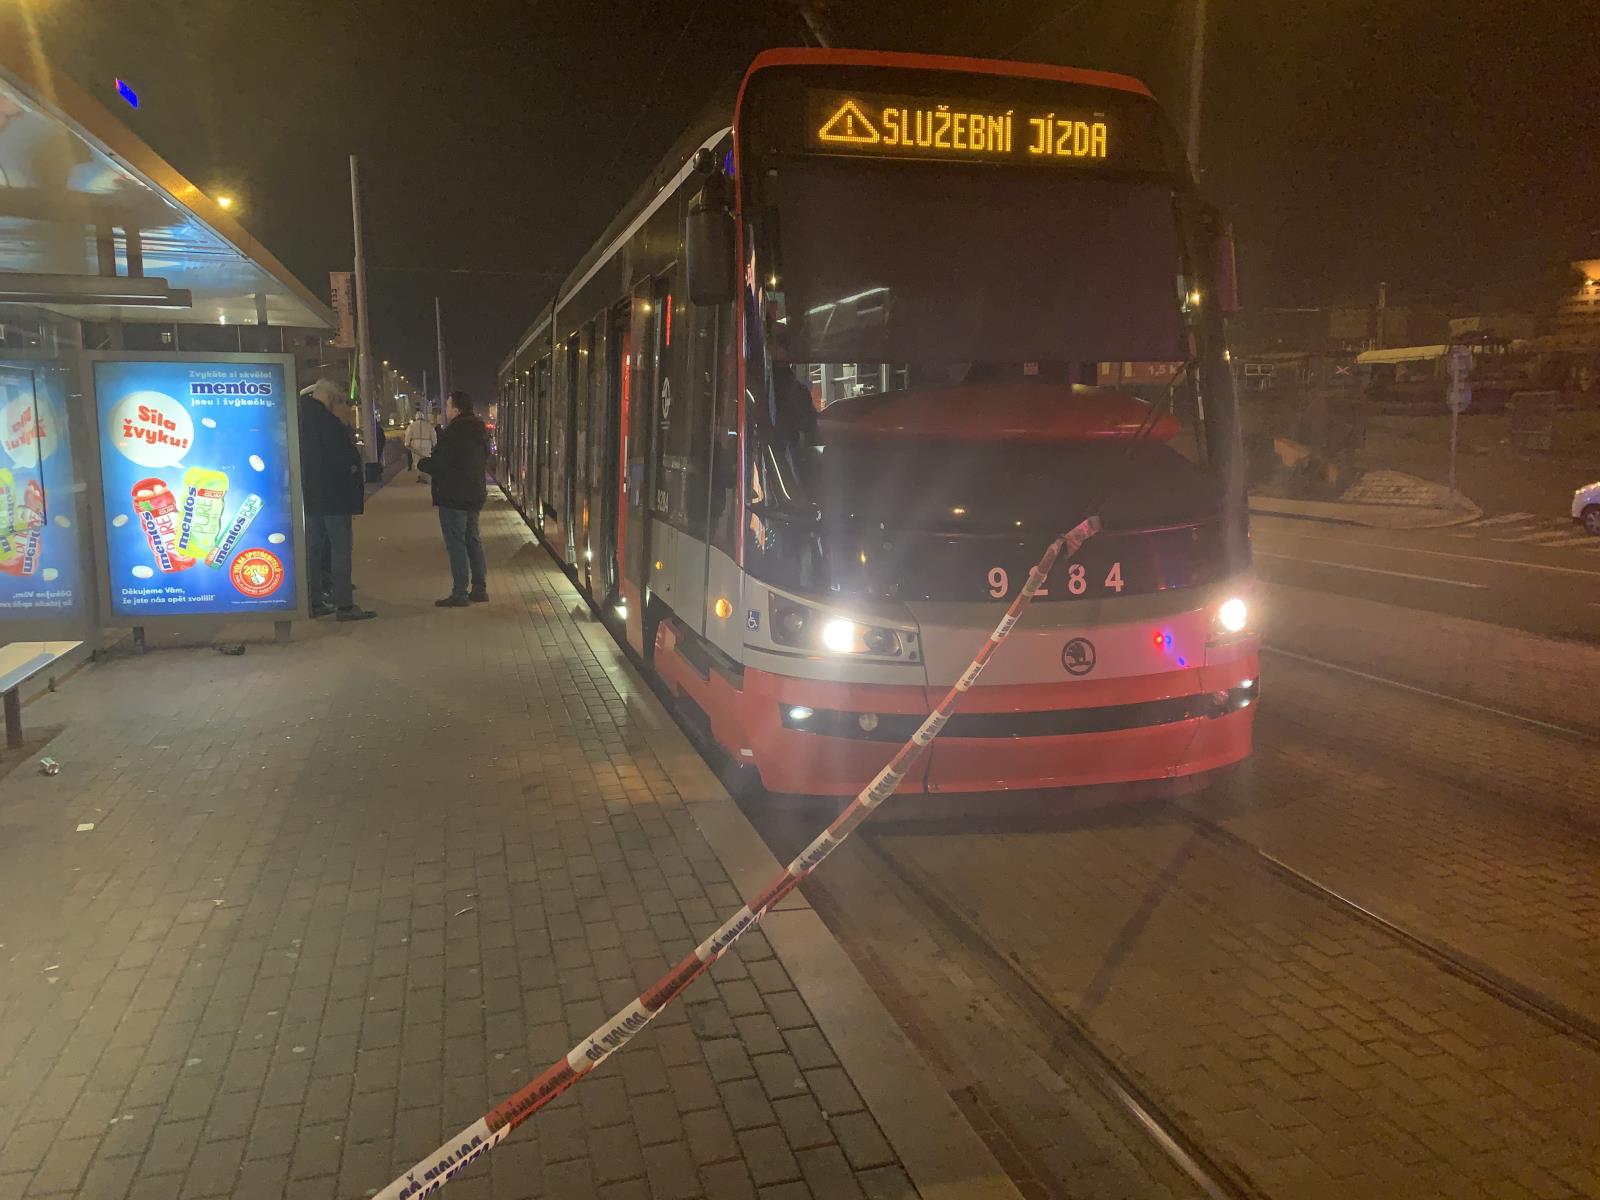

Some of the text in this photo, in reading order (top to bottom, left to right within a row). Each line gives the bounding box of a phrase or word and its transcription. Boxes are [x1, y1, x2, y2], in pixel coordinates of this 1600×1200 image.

[882, 104, 1107, 158] SLUŽEBNÍ JÍZDA
[190, 380, 272, 395] mentos
[191, 397, 214, 406] jsou
[123, 418, 188, 448] žvyku!
[138, 405, 176, 431] Síla
[179, 486, 197, 549] mentos
[142, 511, 172, 569] mentos
[215, 516, 246, 564] mentos
